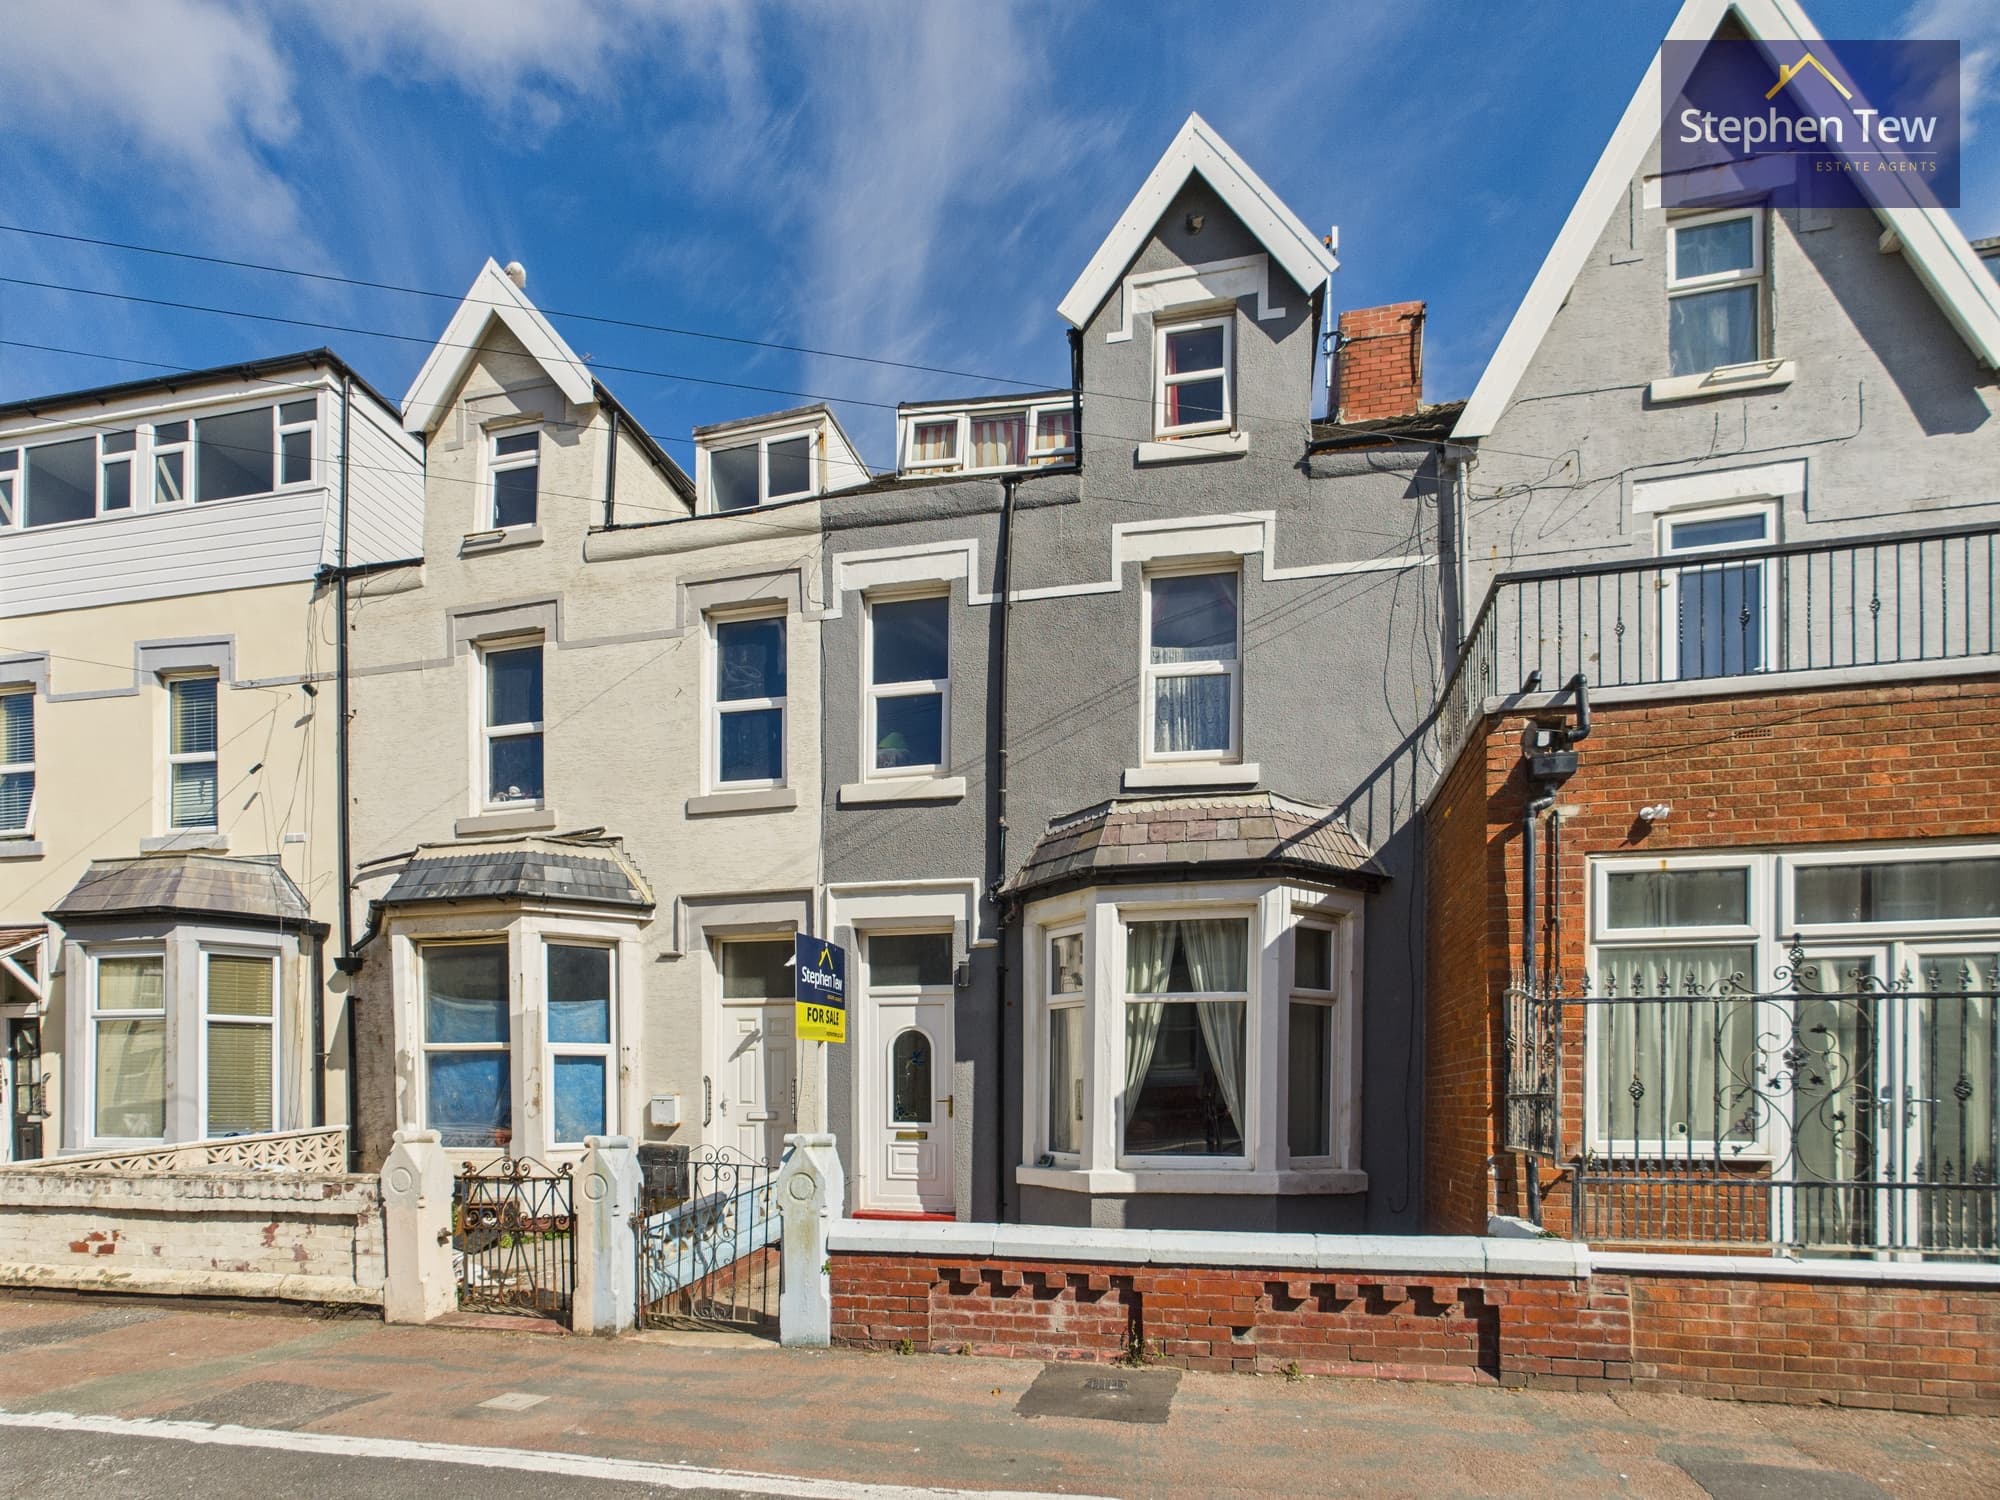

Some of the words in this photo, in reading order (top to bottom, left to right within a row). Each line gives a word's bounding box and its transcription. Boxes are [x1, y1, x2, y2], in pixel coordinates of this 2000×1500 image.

[801, 966, 832, 989] Stephen
[832, 974, 842, 991] Tew
[807, 1007, 824, 1023] FOR
[826, 1010, 839, 1025] SALE
